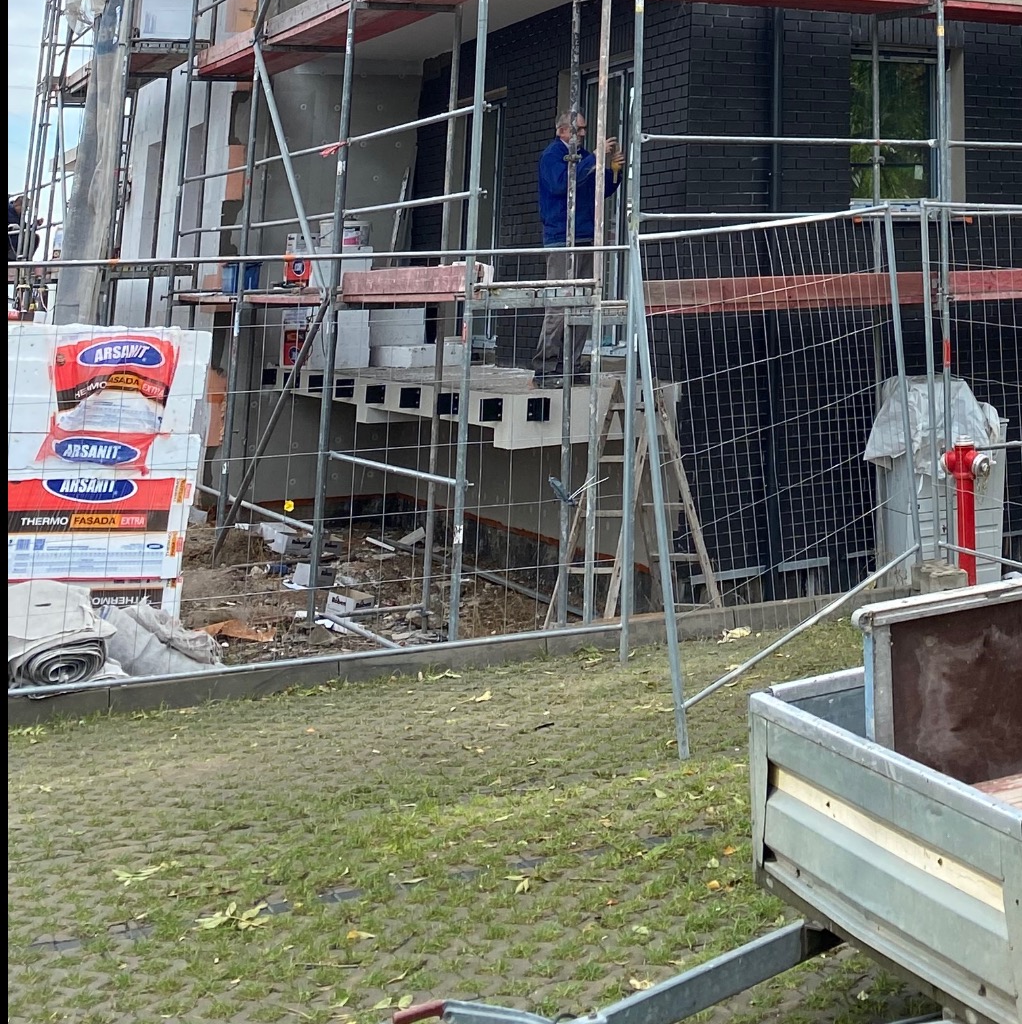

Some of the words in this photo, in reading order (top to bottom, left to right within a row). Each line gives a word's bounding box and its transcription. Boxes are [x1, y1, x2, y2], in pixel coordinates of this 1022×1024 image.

[94, 344, 151, 364] ARSANIT
[109, 375, 140, 386] ASADA
[63, 443, 122, 460] ARSANIT
[60, 477, 117, 494] ARSANIT
[20, 516, 69, 527] THERMO
[73, 516, 117, 527] FASADA
[121, 516, 145, 527] EXTRA
[91, 595, 139, 606] THERMO
